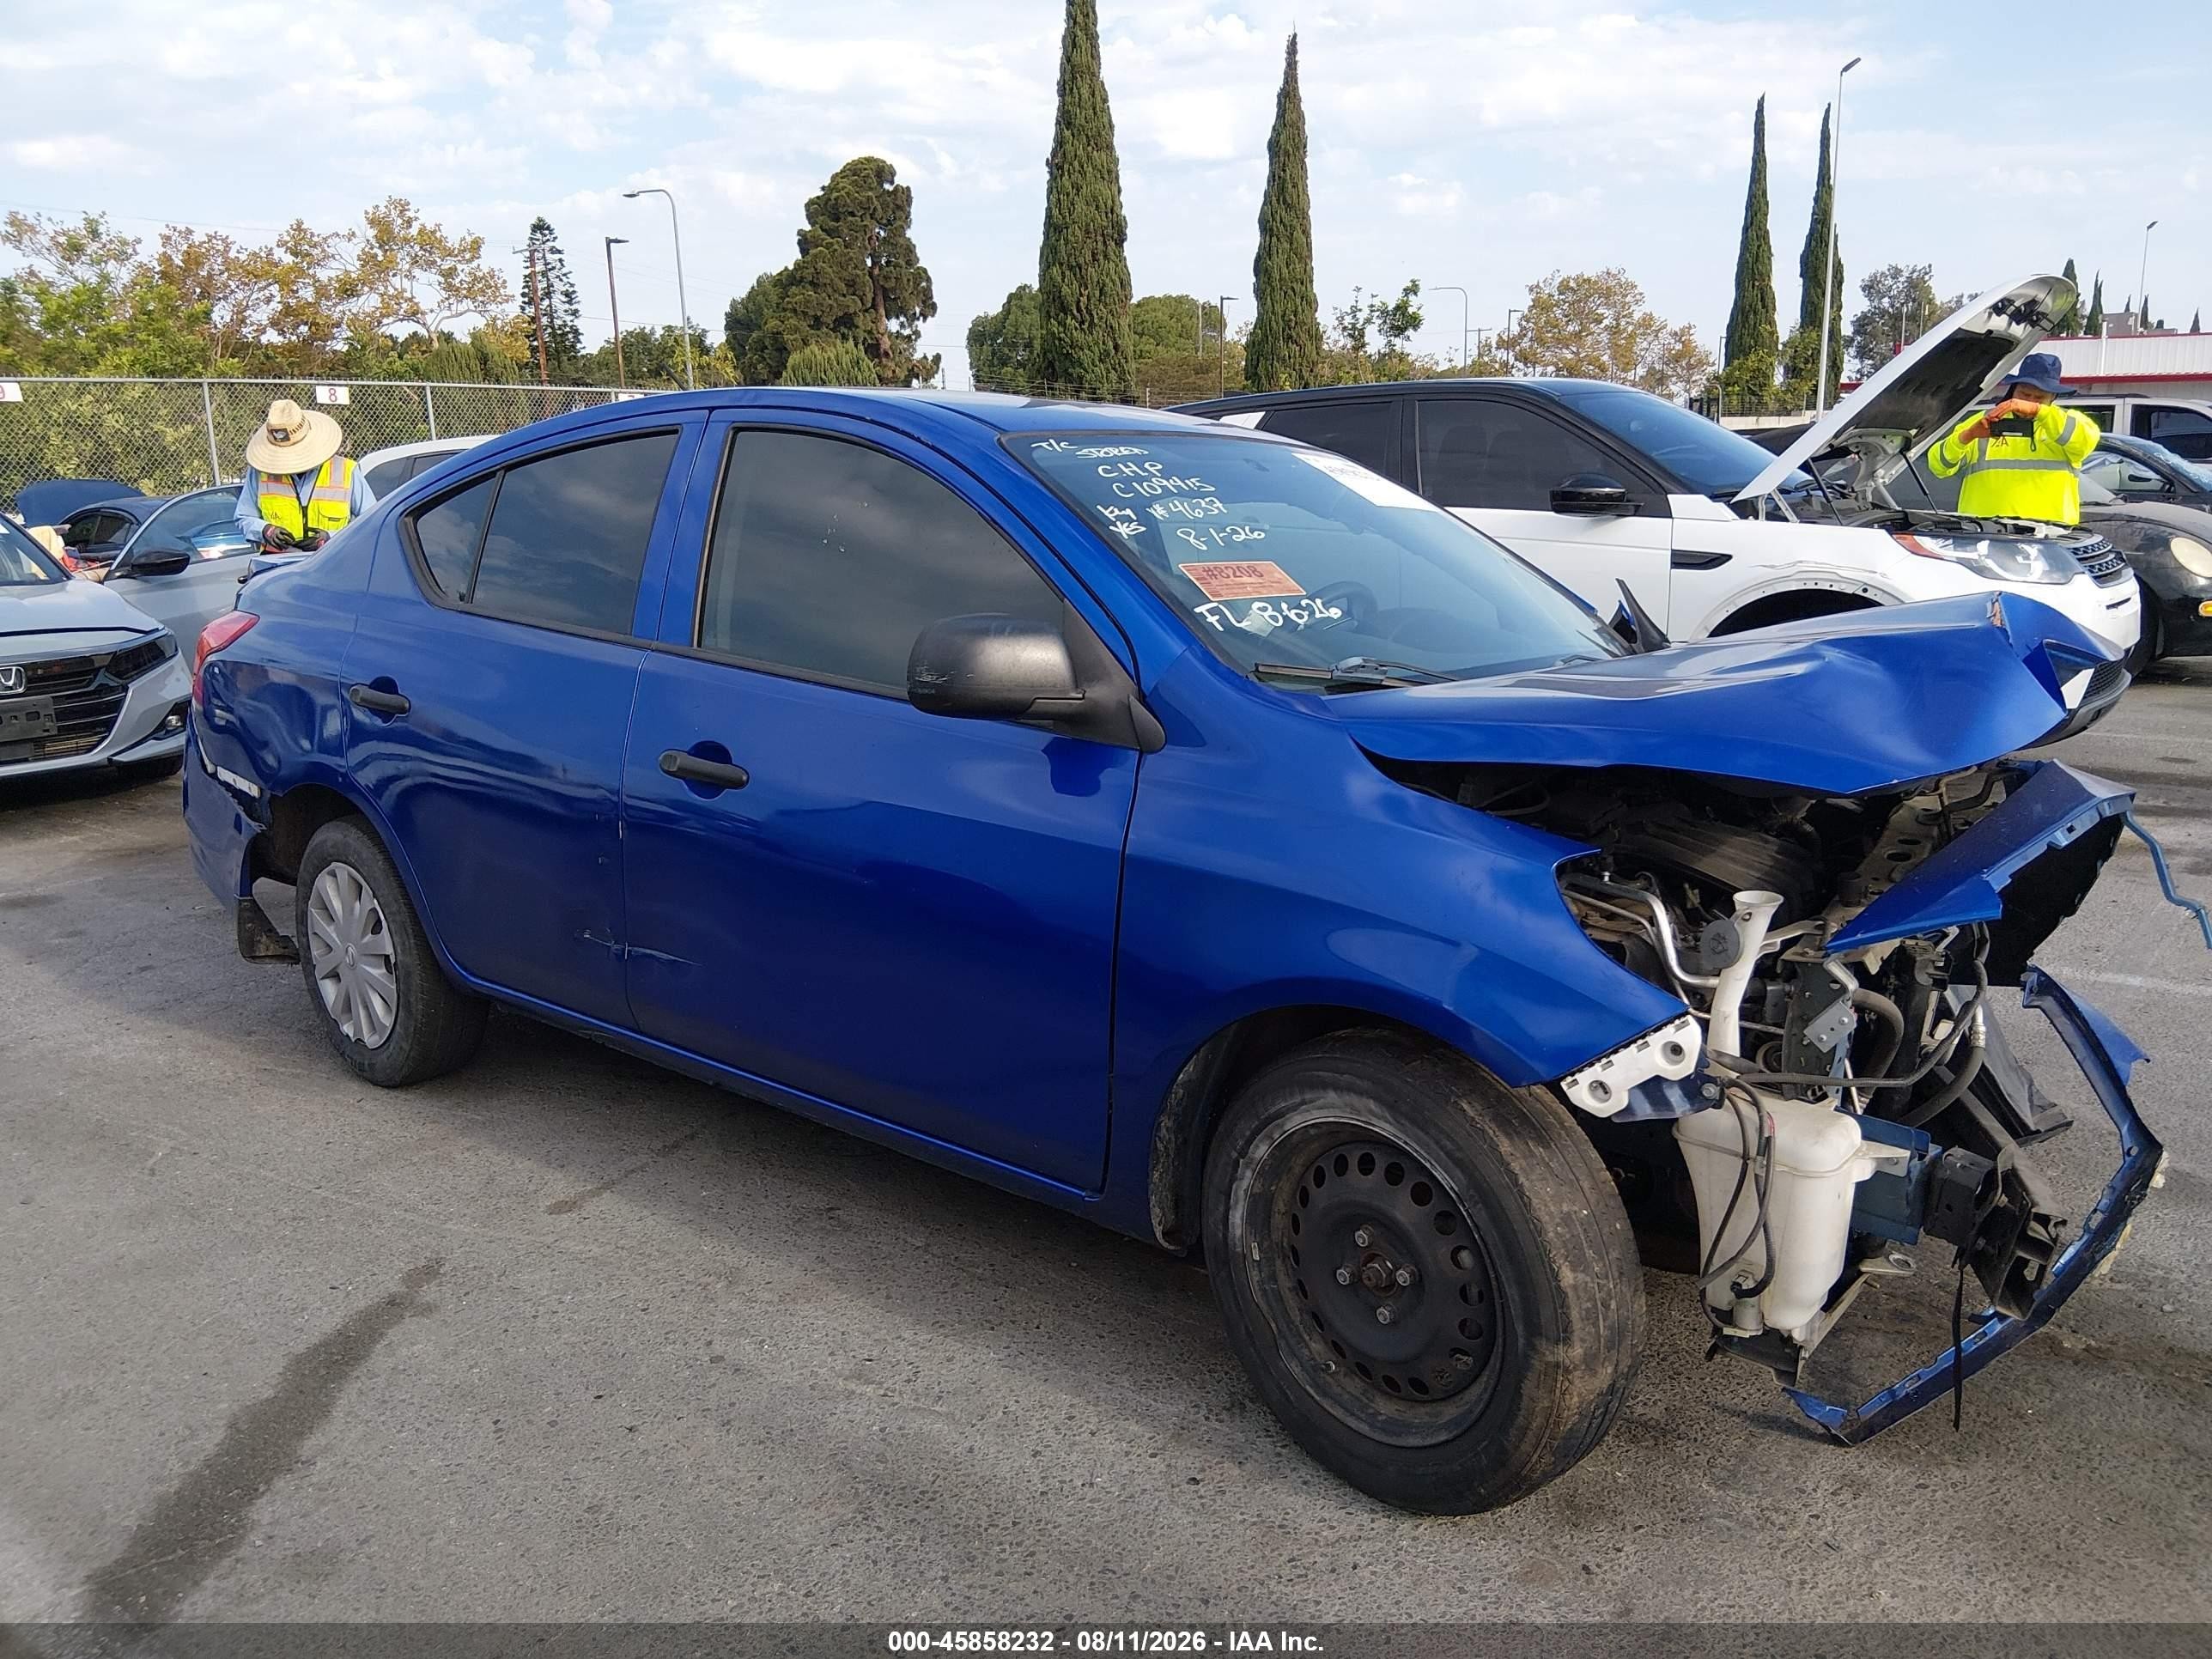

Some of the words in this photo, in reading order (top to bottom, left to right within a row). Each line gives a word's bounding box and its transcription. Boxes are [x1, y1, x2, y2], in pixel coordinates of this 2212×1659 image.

[328, 387, 337, 403] 8
[1176, 526, 1266, 550] 8-1-26
[1202, 565, 1264, 580] #8208
